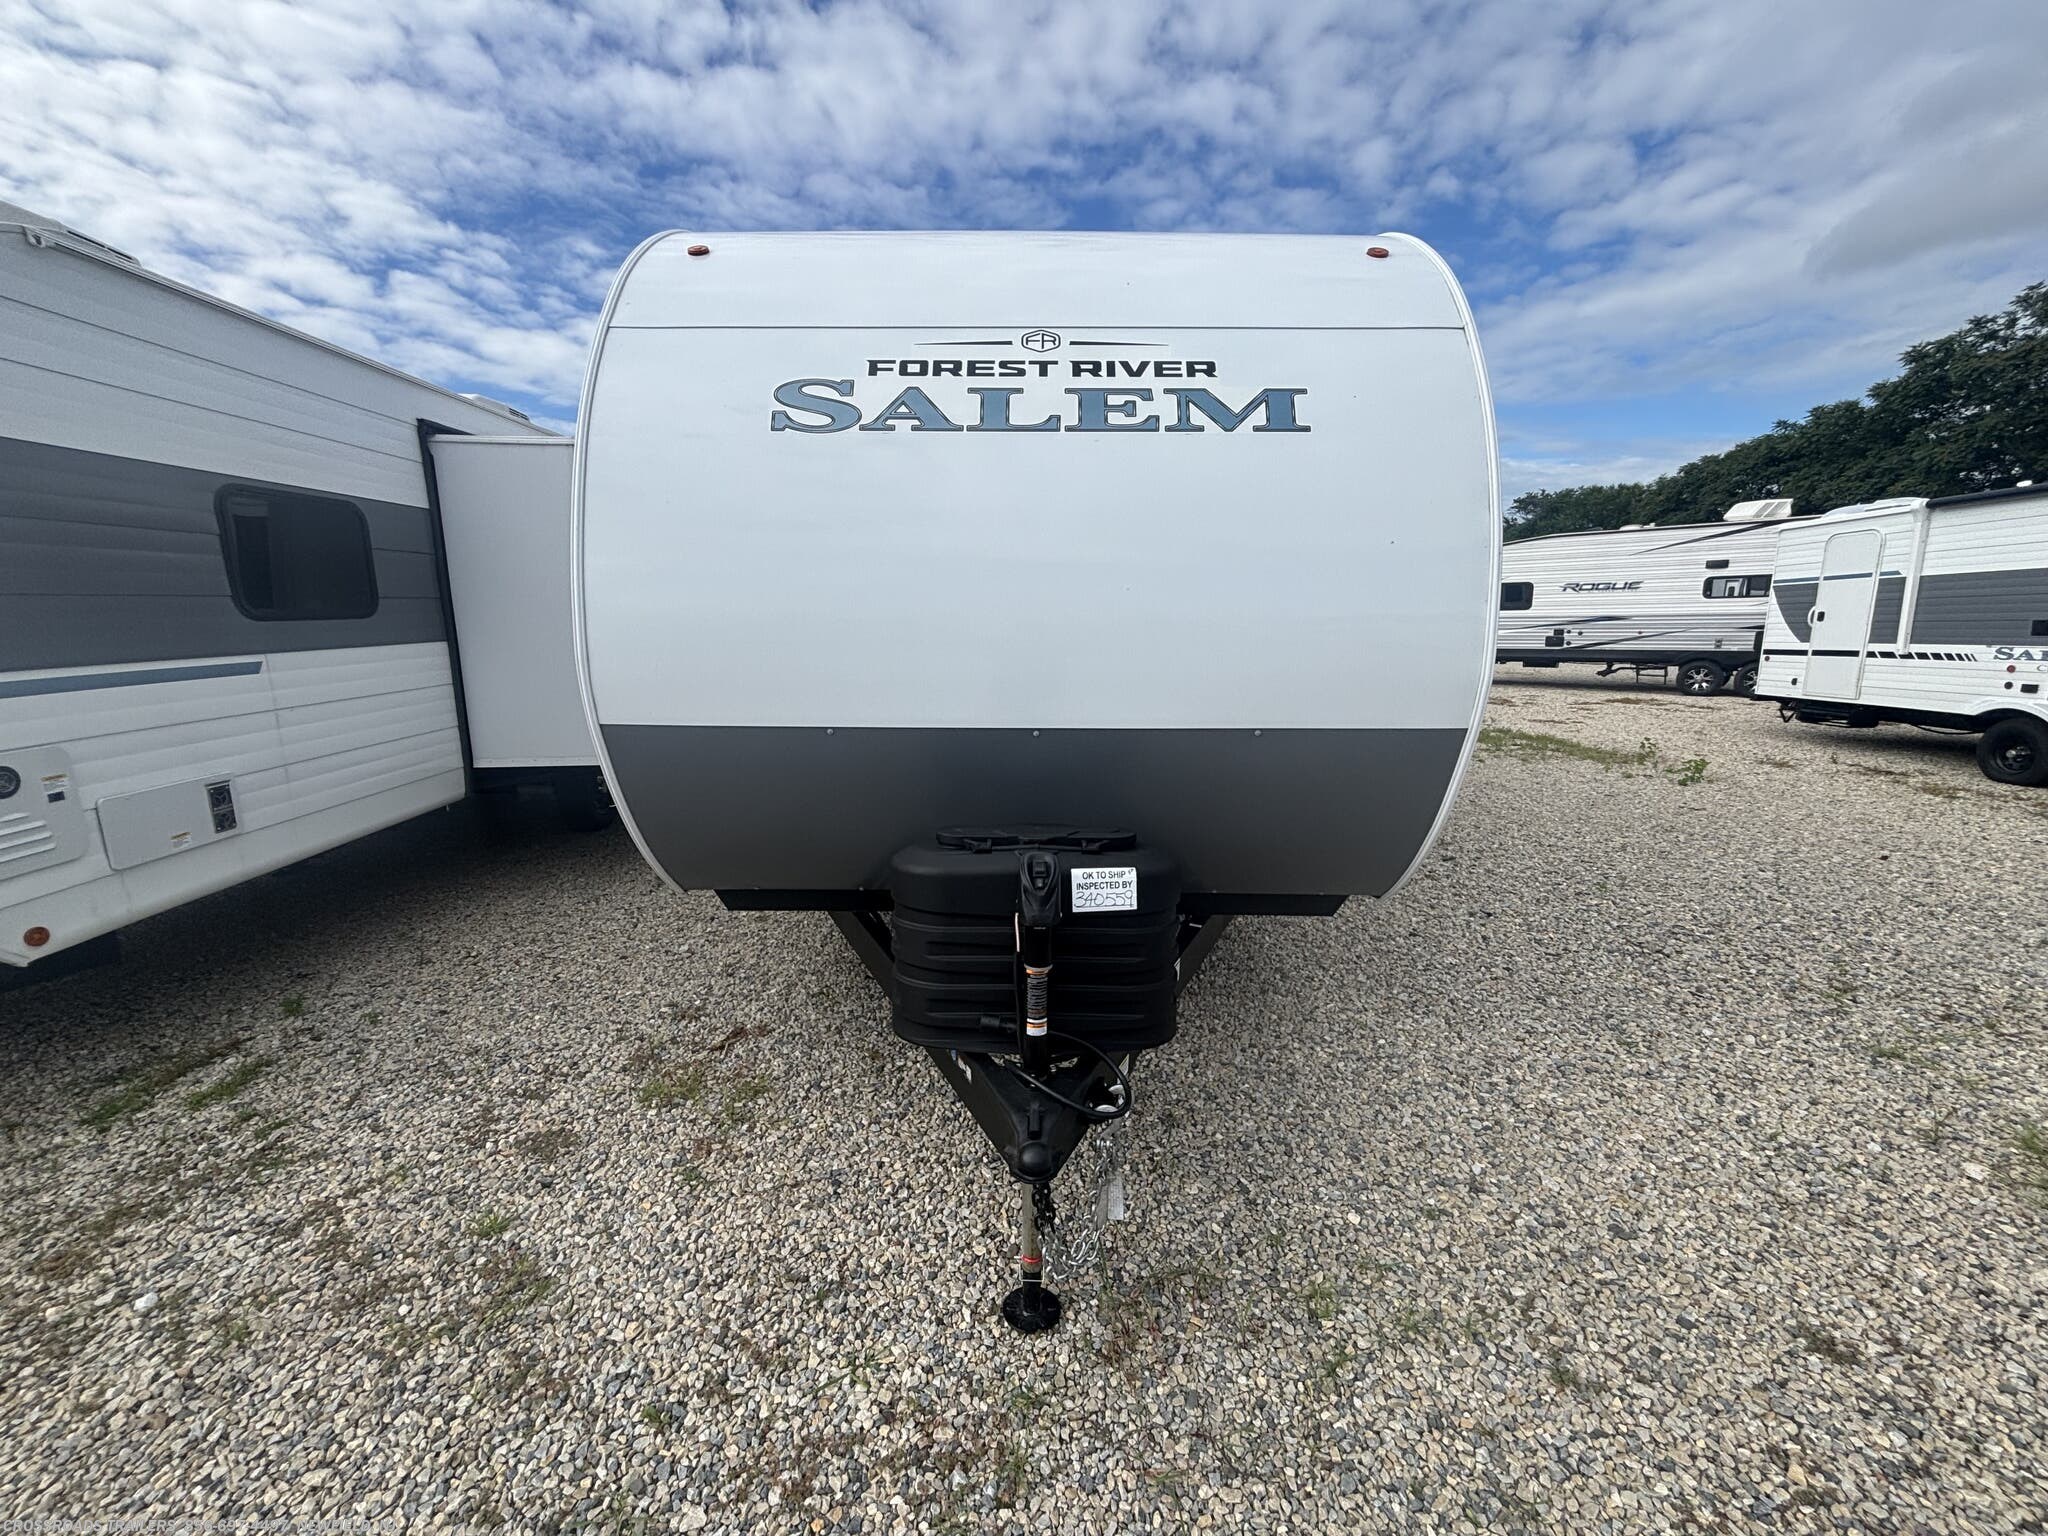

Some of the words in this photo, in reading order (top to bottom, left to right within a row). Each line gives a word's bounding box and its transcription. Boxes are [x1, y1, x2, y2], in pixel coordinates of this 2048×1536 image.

[867, 359, 1058, 378] FOREST
[1071, 360, 1217, 379] RIVER
[770, 378, 1311, 432] SALEM
[1560, 581, 1644, 592] ROGUE
[1082, 871, 1095, 880] OK
[1096, 871, 1107, 879] TO
[1108, 870, 1126, 879] SHIP
[1076, 881, 1121, 891] INSPECTED
[1122, 880, 1133, 889] BY
[1074, 890, 1134, 908] 340559
